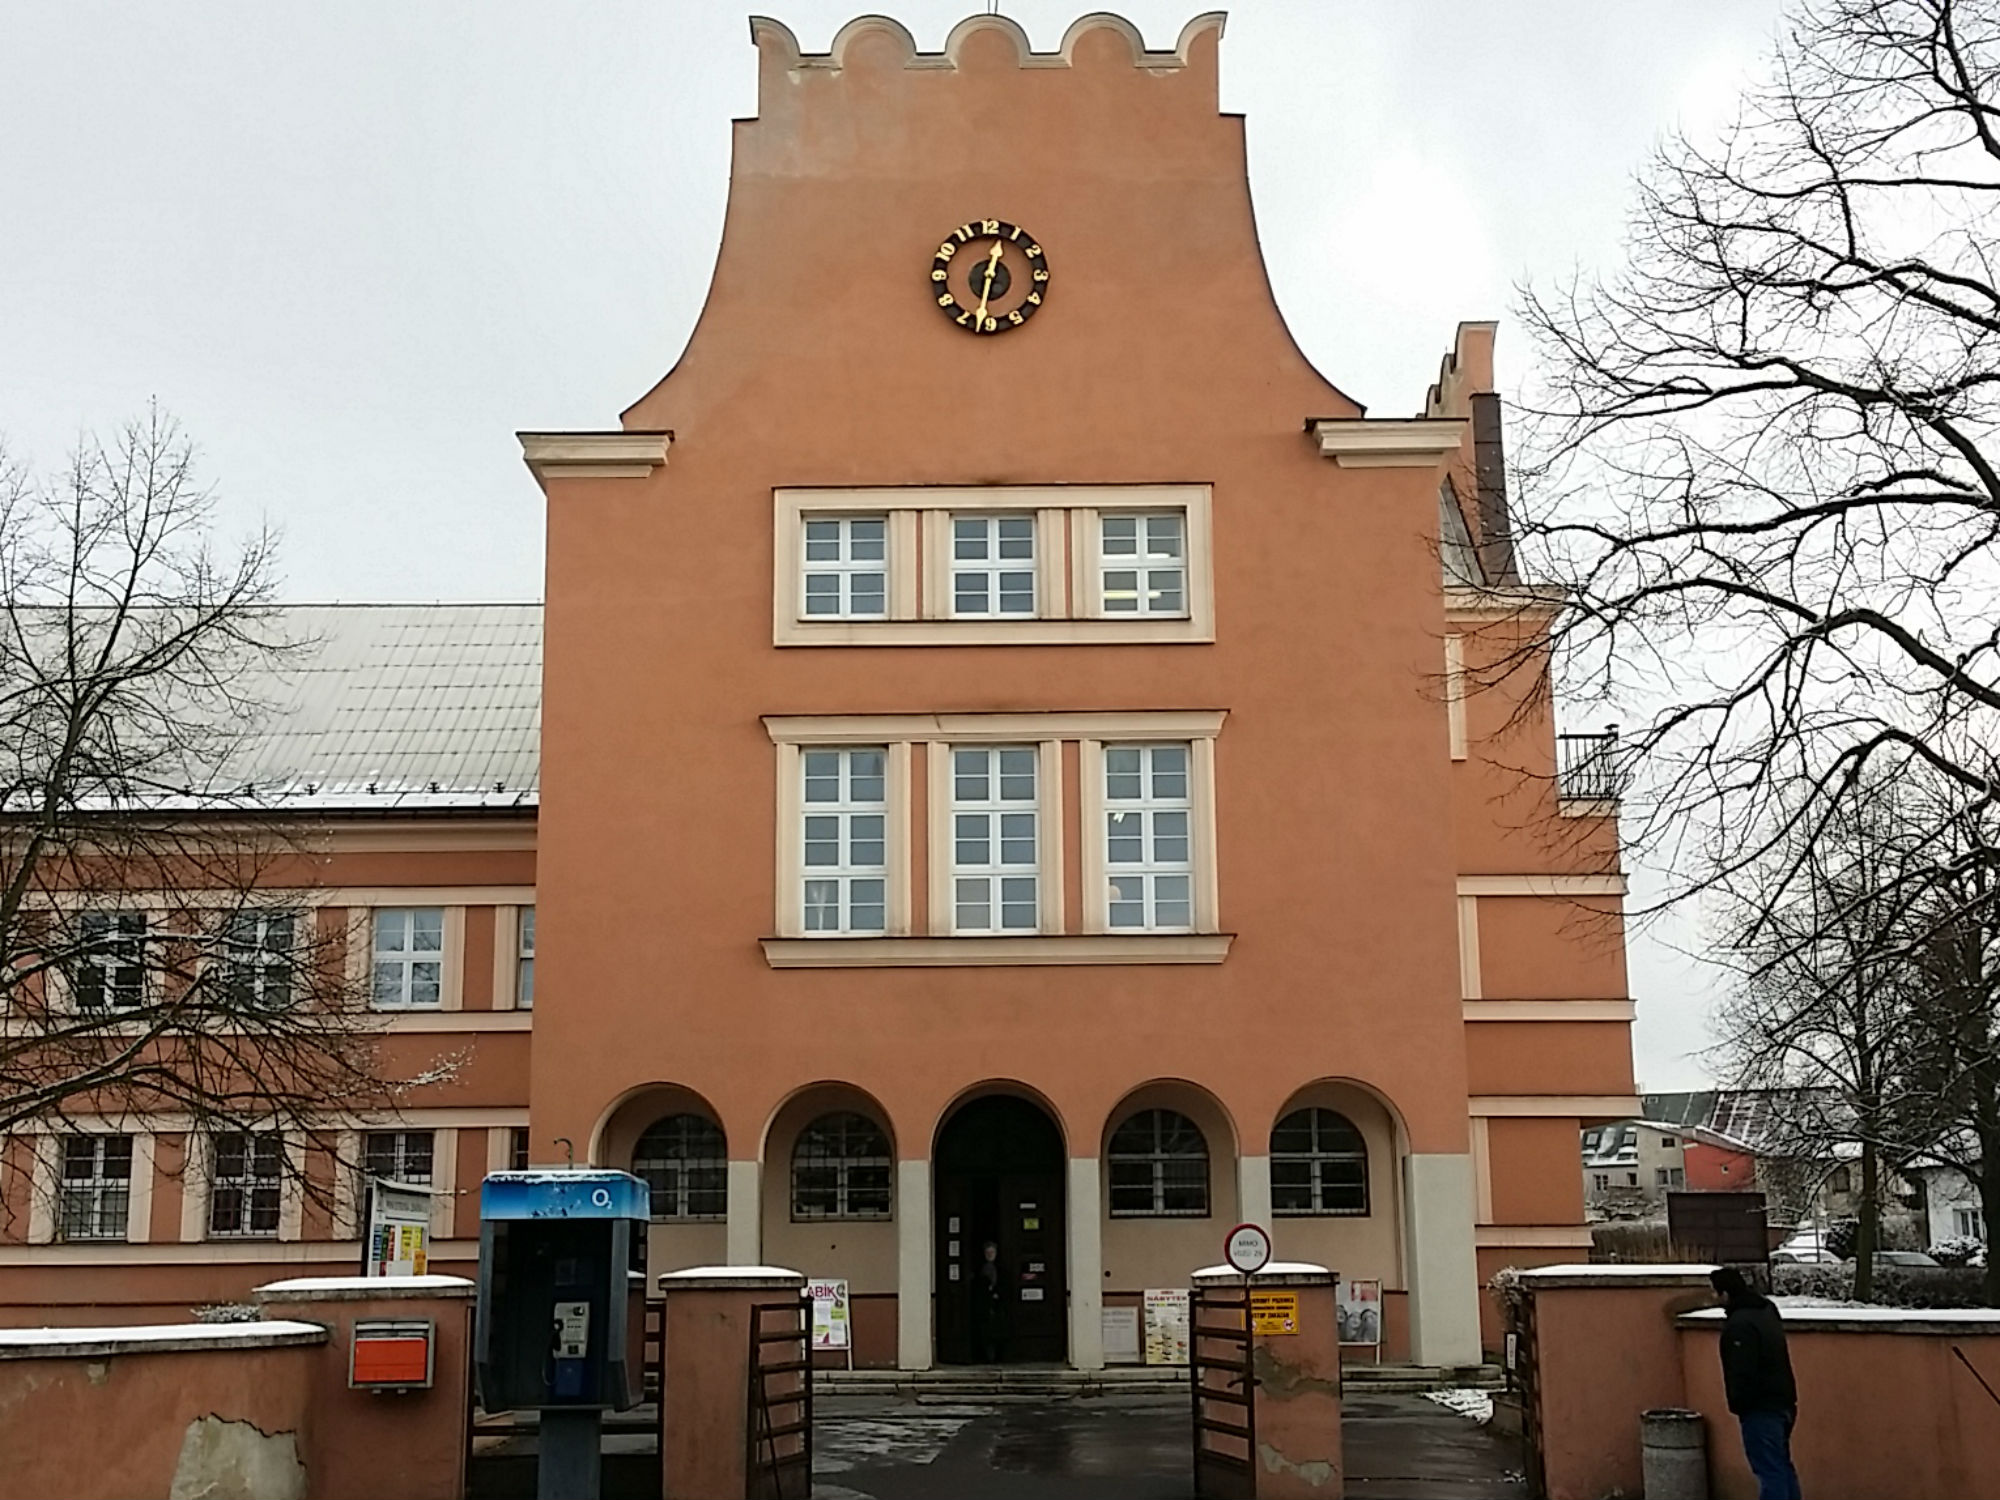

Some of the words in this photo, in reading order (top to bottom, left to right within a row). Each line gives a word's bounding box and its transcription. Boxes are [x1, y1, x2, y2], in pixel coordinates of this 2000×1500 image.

[954, 224, 975, 242] 11
[980, 220, 999, 234] 12
[1010, 226, 1021, 241] 1
[935, 242, 955, 262] 10
[1024, 244, 1041, 258] 2
[931, 269, 947, 281] 9
[1033, 269, 1049, 281] 3
[938, 293, 954, 307] 8
[1026, 292, 1041, 305] 4
[956, 311, 970, 325] 7
[985, 317, 997, 331] 6
[1009, 310, 1024, 325] 5
[592, 1188, 613, 1210] O2
